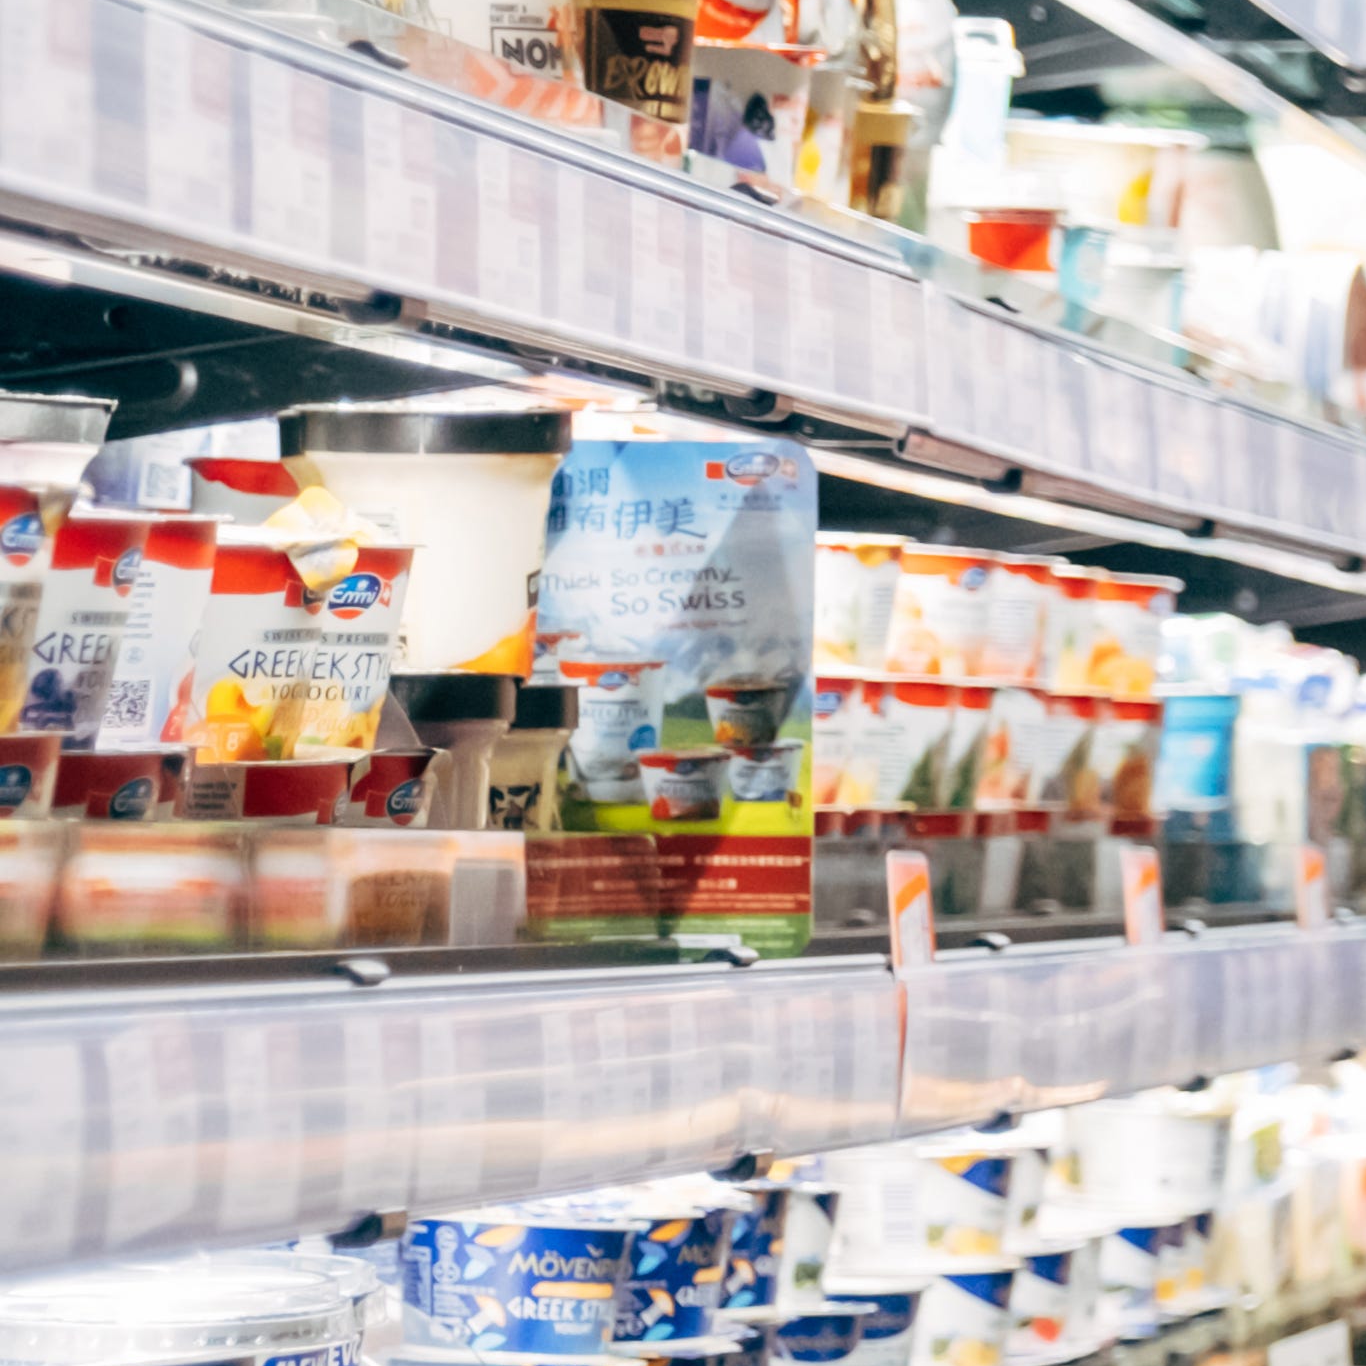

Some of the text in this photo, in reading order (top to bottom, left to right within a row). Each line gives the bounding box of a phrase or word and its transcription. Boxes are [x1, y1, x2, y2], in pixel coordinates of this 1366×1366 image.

[330, 584, 378, 605] Emmi
[611, 587, 746, 617] So Swiss
[307, 685, 371, 702] OGURT
